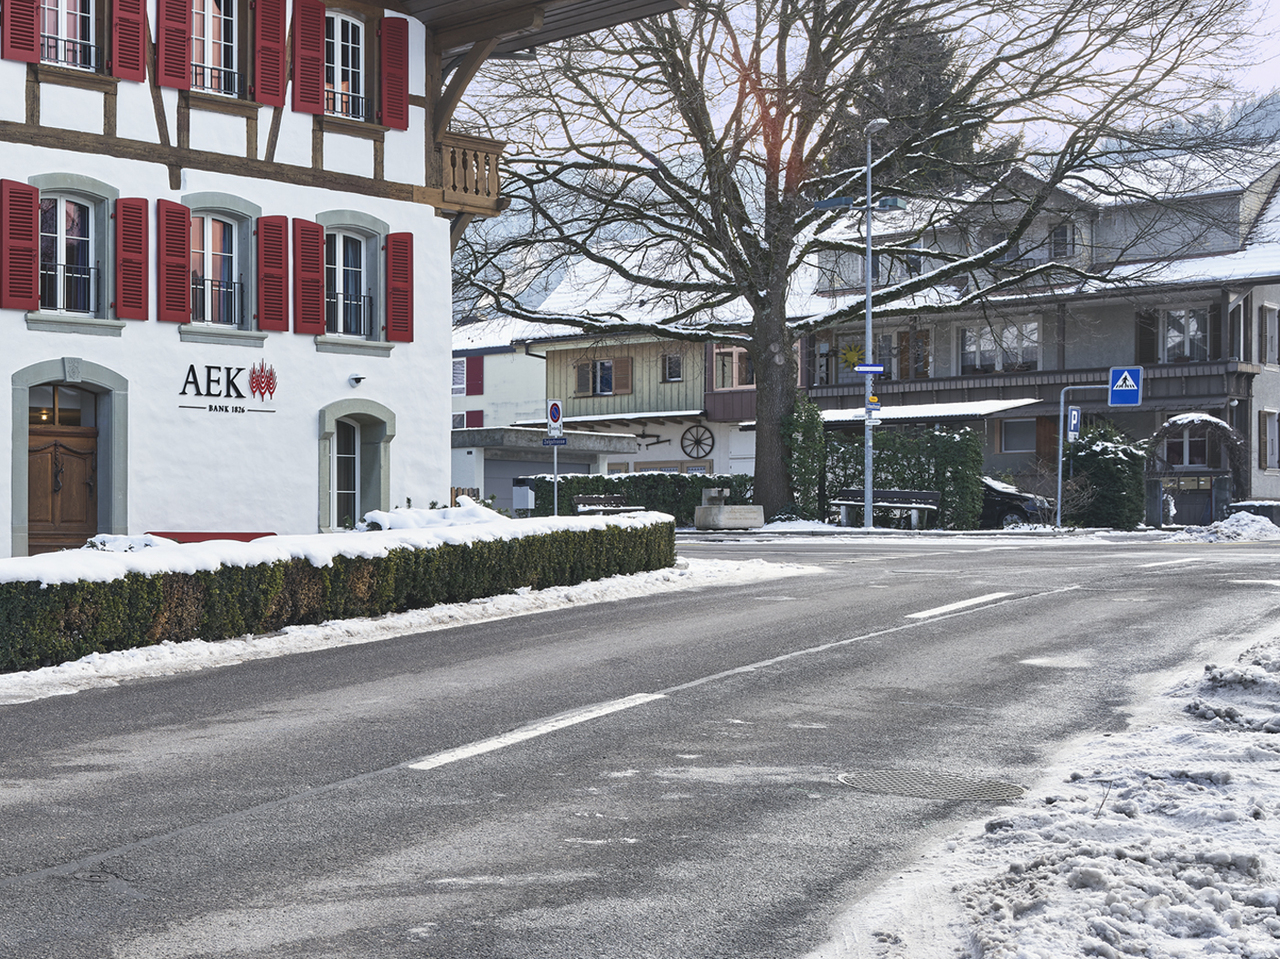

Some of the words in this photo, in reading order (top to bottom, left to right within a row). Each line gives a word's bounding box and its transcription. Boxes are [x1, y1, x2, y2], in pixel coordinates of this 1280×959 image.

[179, 364, 246, 398] AEK
[208, 405, 229, 413] BANK
[1071, 411, 1077, 430] P
